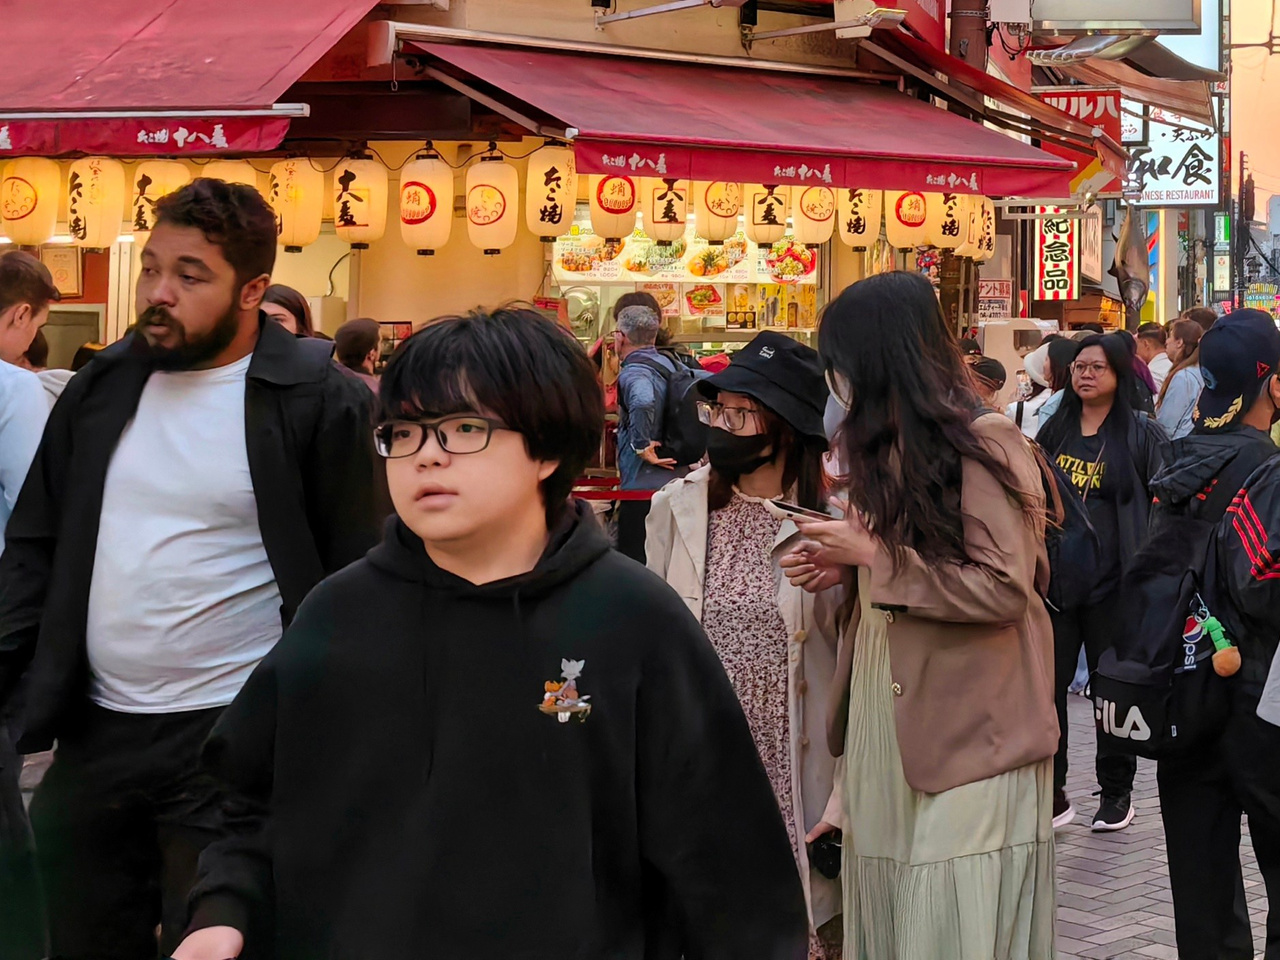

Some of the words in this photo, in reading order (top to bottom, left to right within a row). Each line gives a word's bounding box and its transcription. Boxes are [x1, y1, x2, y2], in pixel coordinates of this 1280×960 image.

[539, 166, 563, 225] たこ焼
[1166, 189, 1214, 200] RESTAURANT
[1043, 217, 1070, 291] 紀念品
